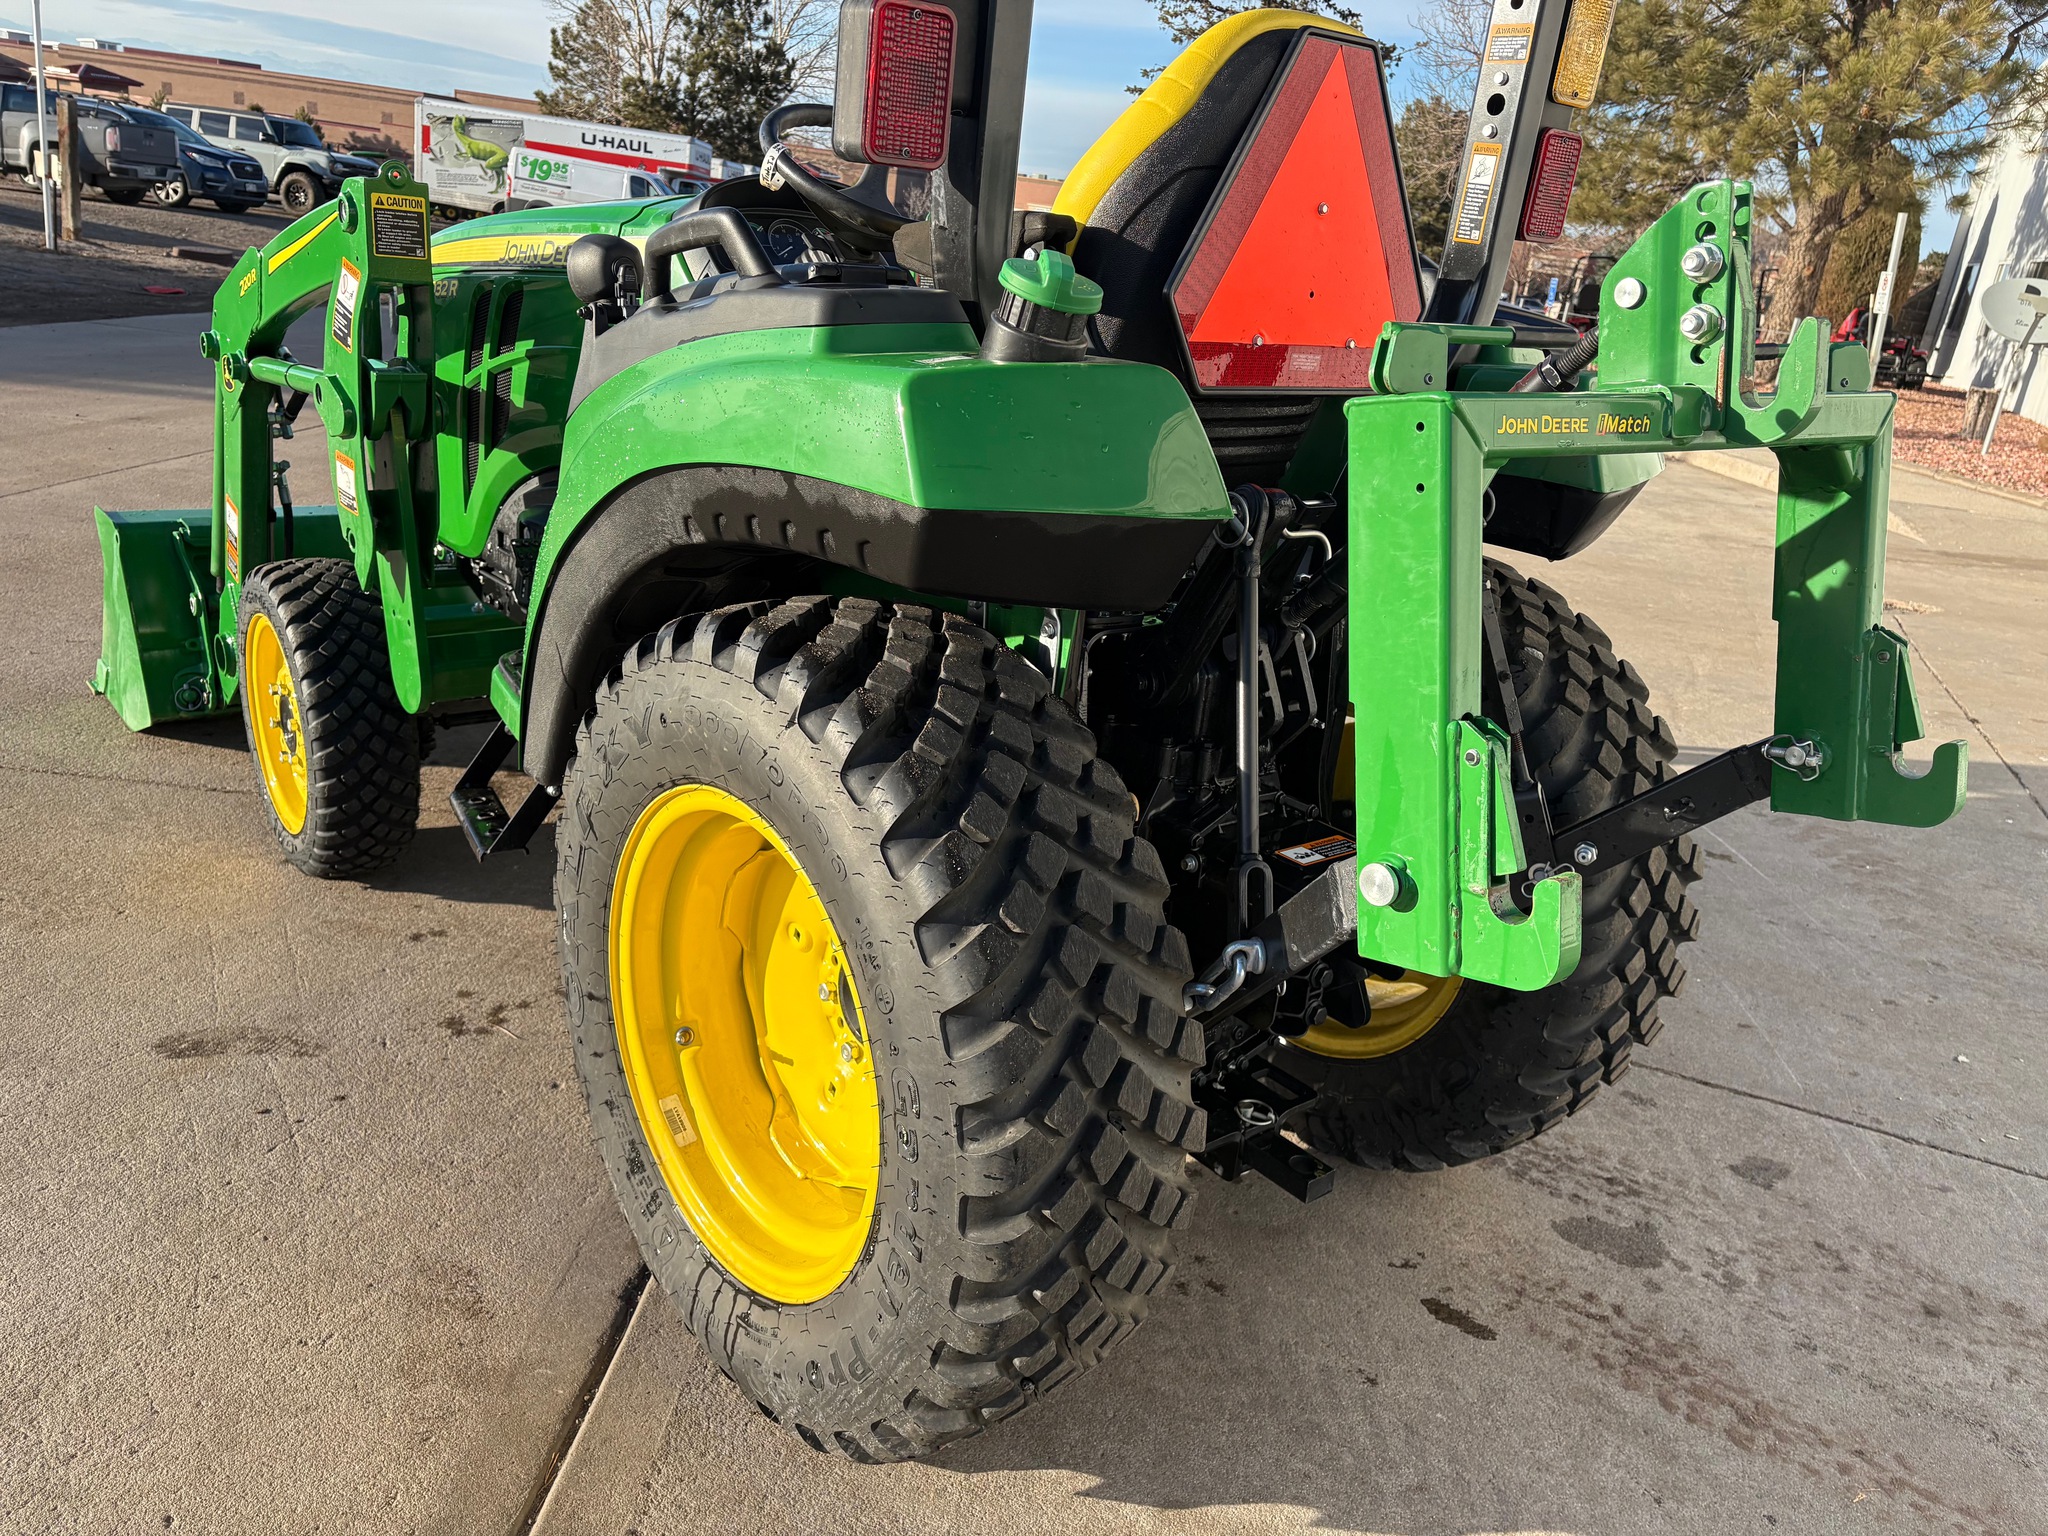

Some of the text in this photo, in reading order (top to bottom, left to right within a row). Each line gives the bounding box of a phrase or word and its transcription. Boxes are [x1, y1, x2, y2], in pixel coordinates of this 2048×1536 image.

[581, 132, 654, 155] U-HAUL
[386, 196, 423, 209] CAUTION
[499, 240, 540, 264] JOHN
[1497, 414, 1538, 434] JOHN
[1541, 414, 1589, 434] DEERE
